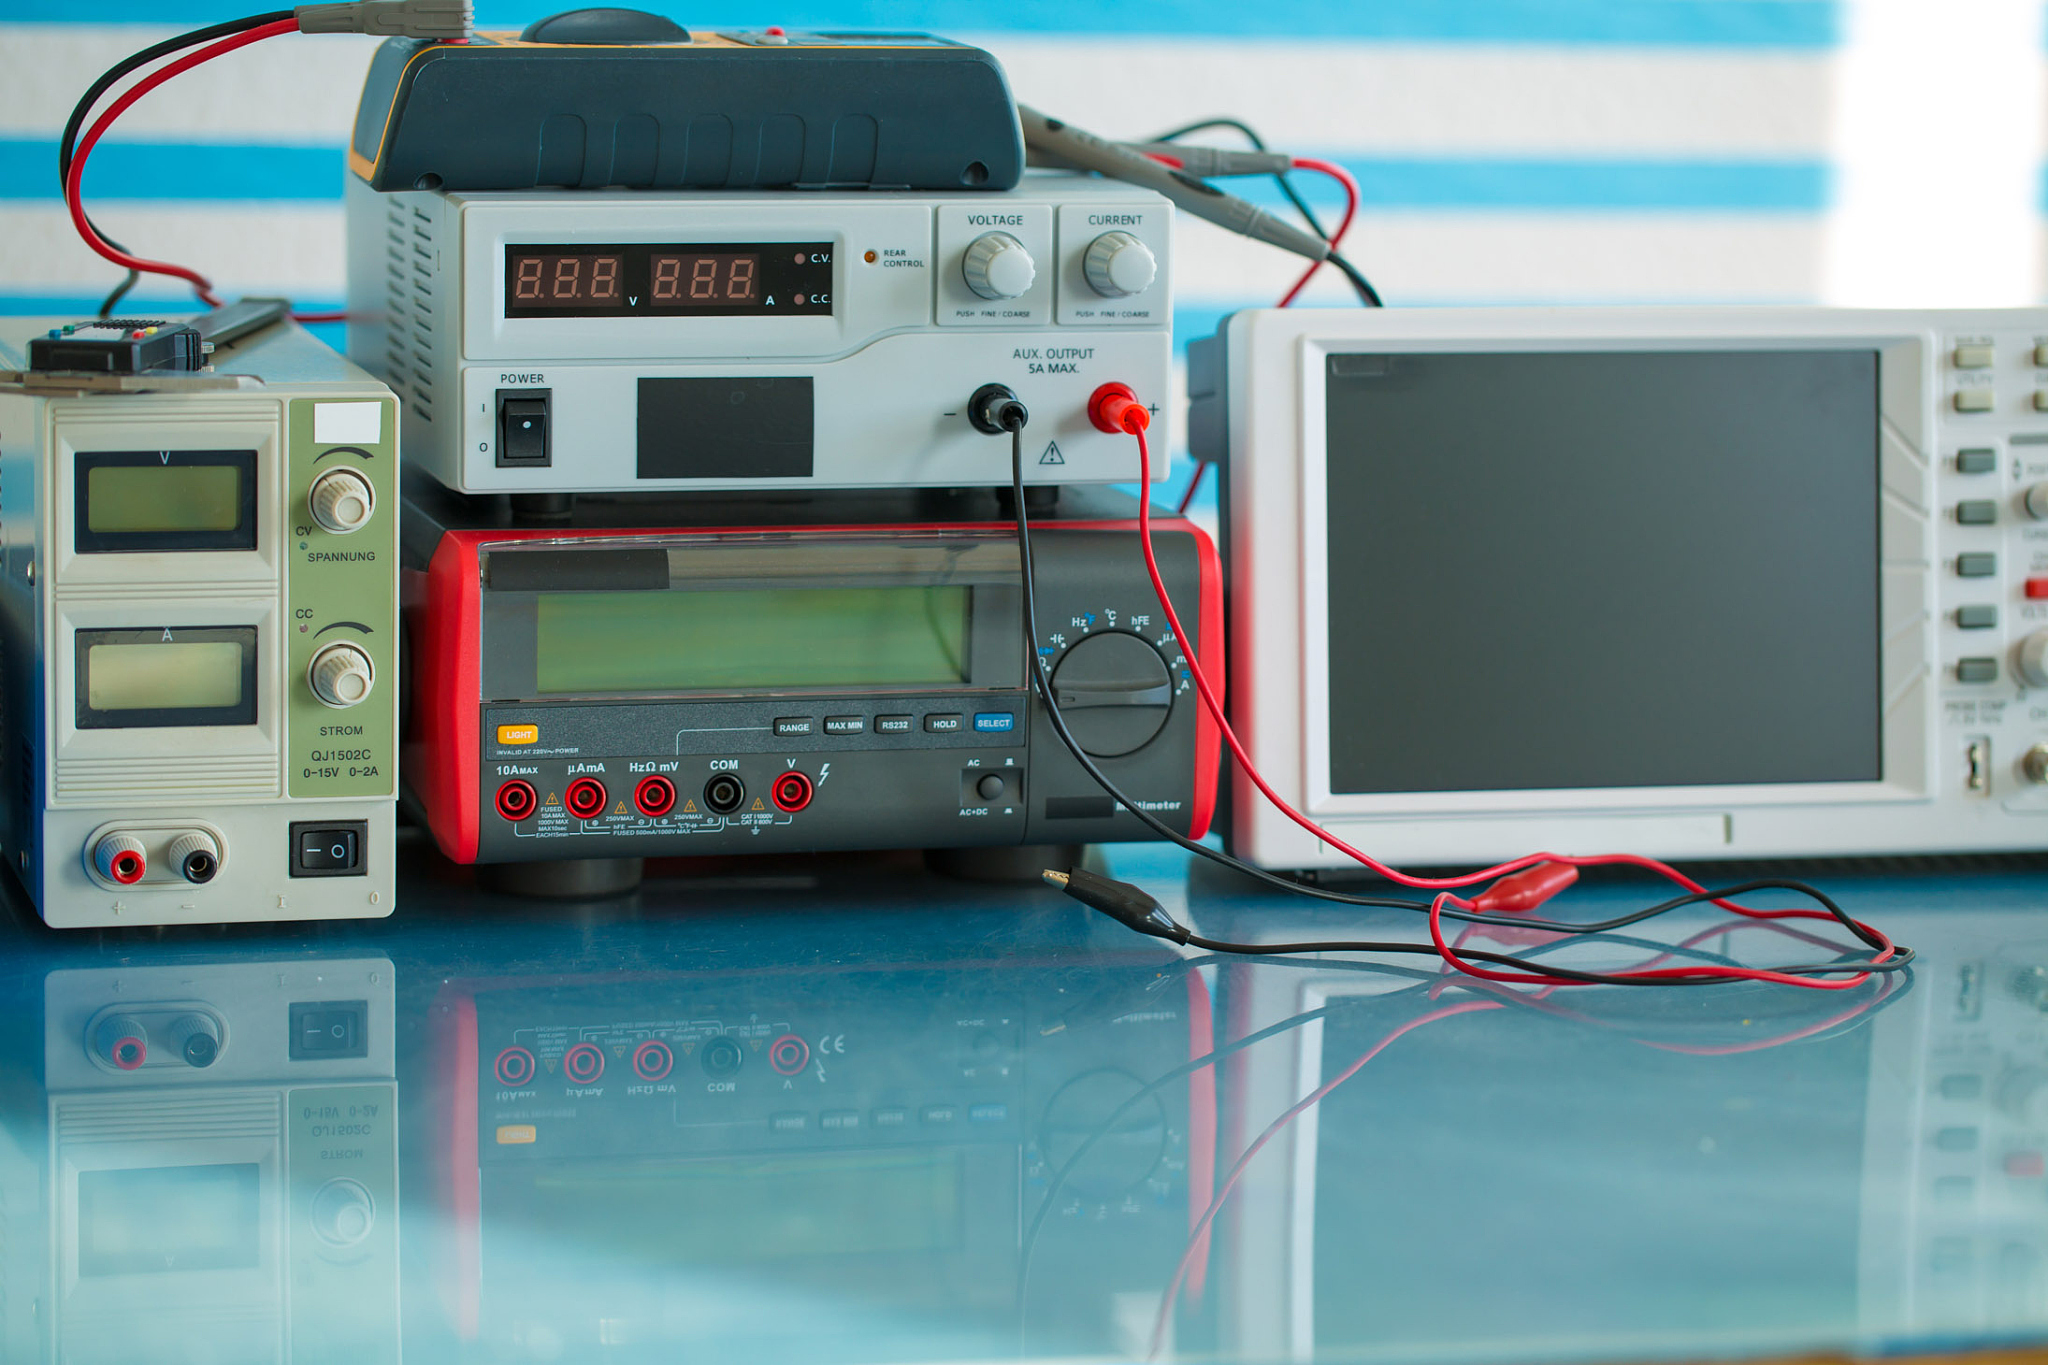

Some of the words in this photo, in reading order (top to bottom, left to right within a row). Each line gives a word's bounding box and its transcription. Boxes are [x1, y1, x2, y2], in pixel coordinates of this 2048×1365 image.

[968, 215, 1023, 226] VOLTAGE
[1088, 215, 1143, 225] CURRENT
[884, 260, 925, 268] CONTROL
[629, 296, 638, 307] V
[765, 295, 775, 306] A
[956, 310, 975, 318] PUSH
[1076, 310, 1094, 318] PUSH
[1013, 348, 1042, 359] AUX.
[1046, 348, 1095, 359] OUTPUT
[1028, 363, 1044, 374] 5A
[1048, 363, 1080, 373] MAX.
[500, 374, 545, 384] POWER
[159, 451, 170, 465] V
[295, 525, 312, 536] CV
[308, 551, 375, 562] SPANNUNG
[295, 608, 313, 619] CC
[1072, 617, 1087, 628] Hz
[1131, 615, 1150, 626] hFE
[162, 627, 173, 642] A
[1181, 679, 1190, 690] A
[779, 723, 810, 732] RANGE
[827, 722, 846, 730] MAX
[848, 721, 863, 729] MIN
[882, 721, 908, 730] RS232
[933, 720, 957, 729] HOLD
[977, 719, 1010, 728] SELECT
[320, 725, 363, 736] STROM
[506, 731, 532, 739] LIGHT
[311, 749, 371, 762] QJ1502C
[659, 761, 679, 771] mV
[710, 759, 739, 770] COM
[786, 758, 796, 769] V
[967, 759, 980, 767] AC
[303, 767, 339, 778] 0-15V
[349, 766, 379, 777] 0-2A
[959, 808, 988, 816] AC+DC
[1116, 801, 1181, 812] Mtimeter
